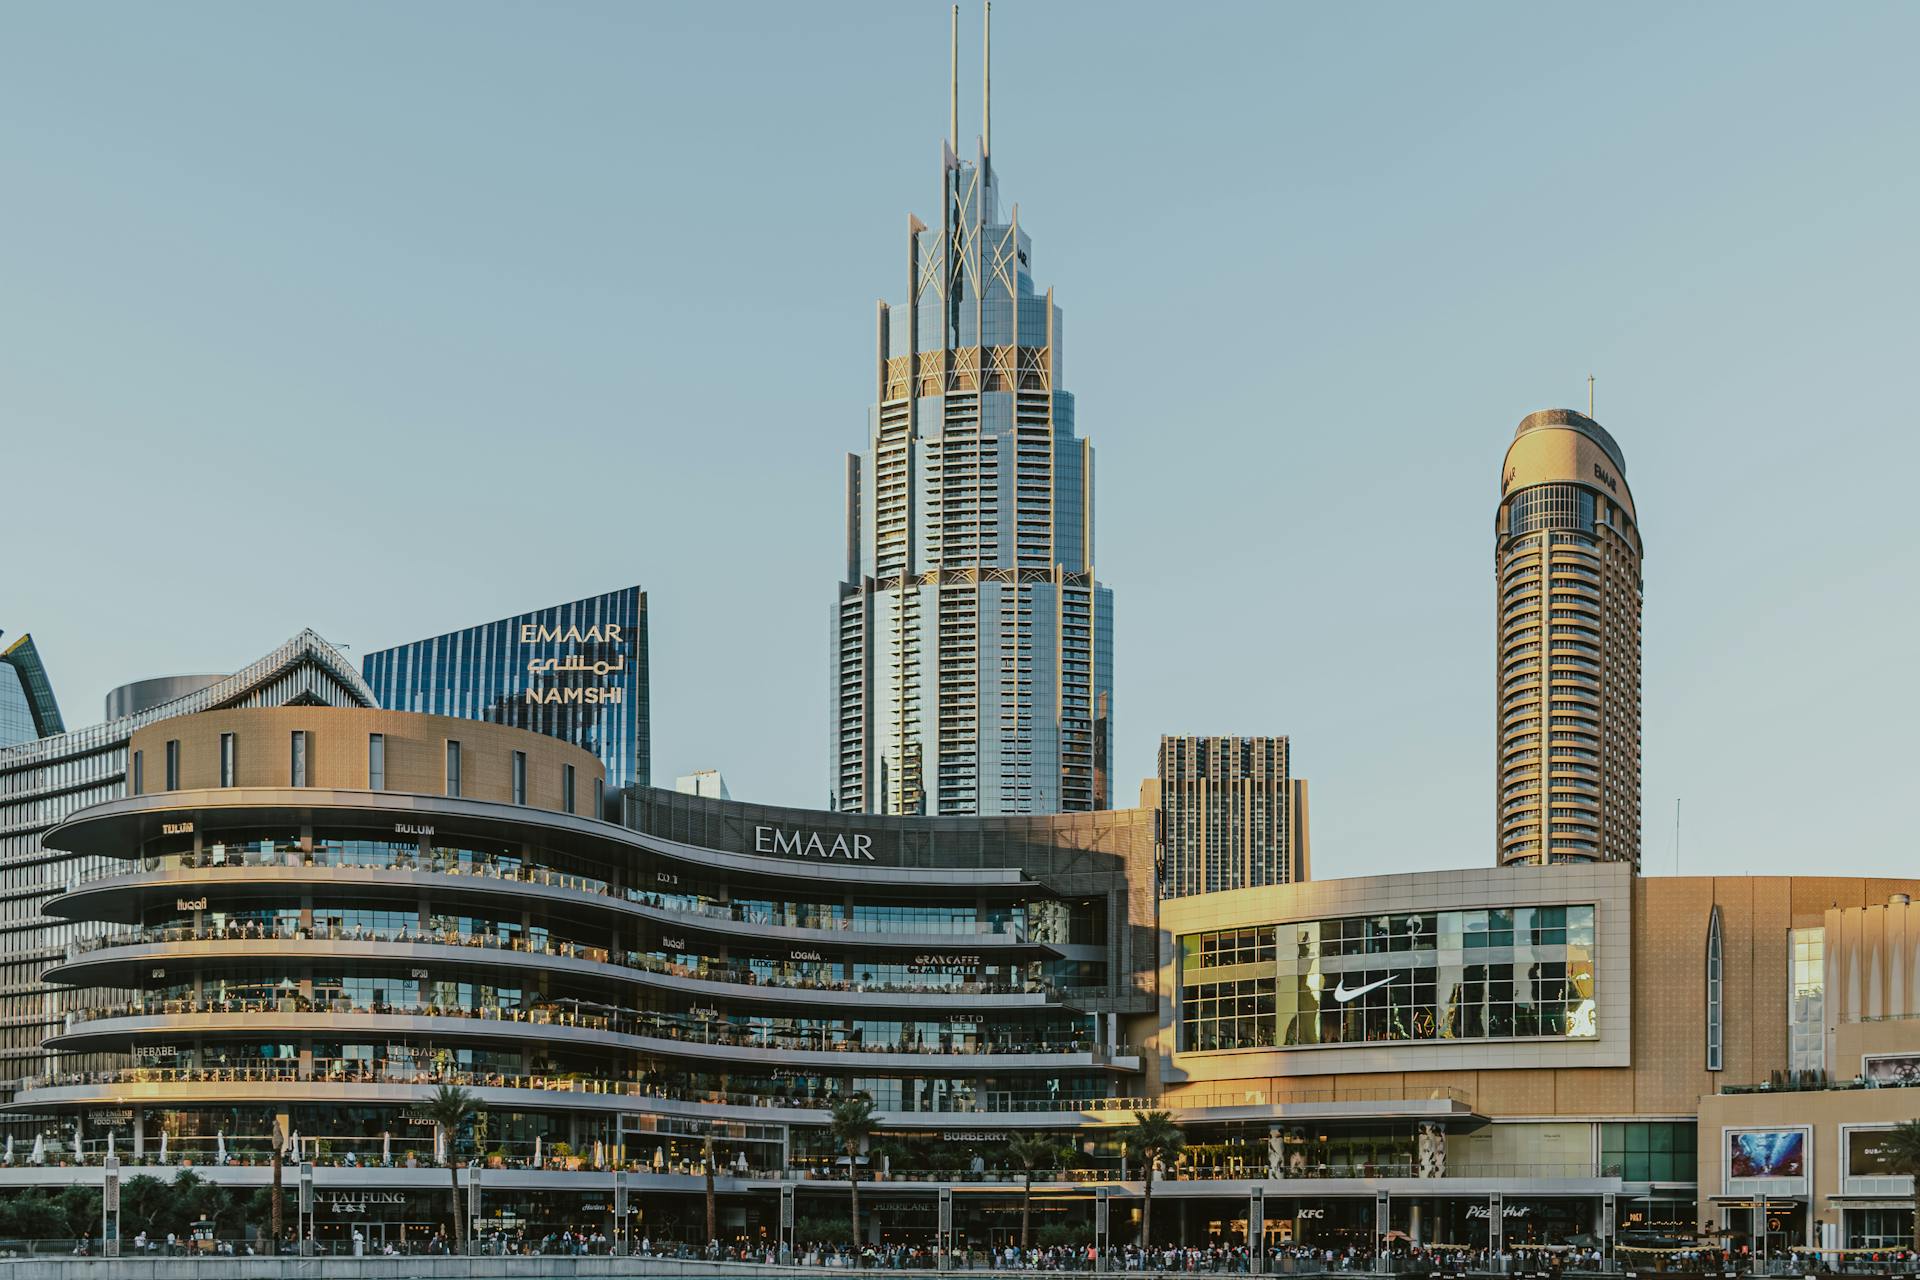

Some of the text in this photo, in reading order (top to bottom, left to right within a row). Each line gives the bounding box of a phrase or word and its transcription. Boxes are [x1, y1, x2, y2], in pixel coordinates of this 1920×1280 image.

[520, 623, 624, 643] EMAAR
[525, 687, 622, 704] NAMSHI
[162, 822, 194, 834] TULUM
[395, 823, 435, 835] TULUM
[755, 825, 876, 860] EMAAR
[943, 1131, 1008, 1141] BURBERRY
[329, 1191, 356, 1203] TAI
[360, 1191, 407, 1204] FUNG
[1297, 1209, 1325, 1219] KFC
[1465, 1205, 1531, 1220] Pizz Hut
